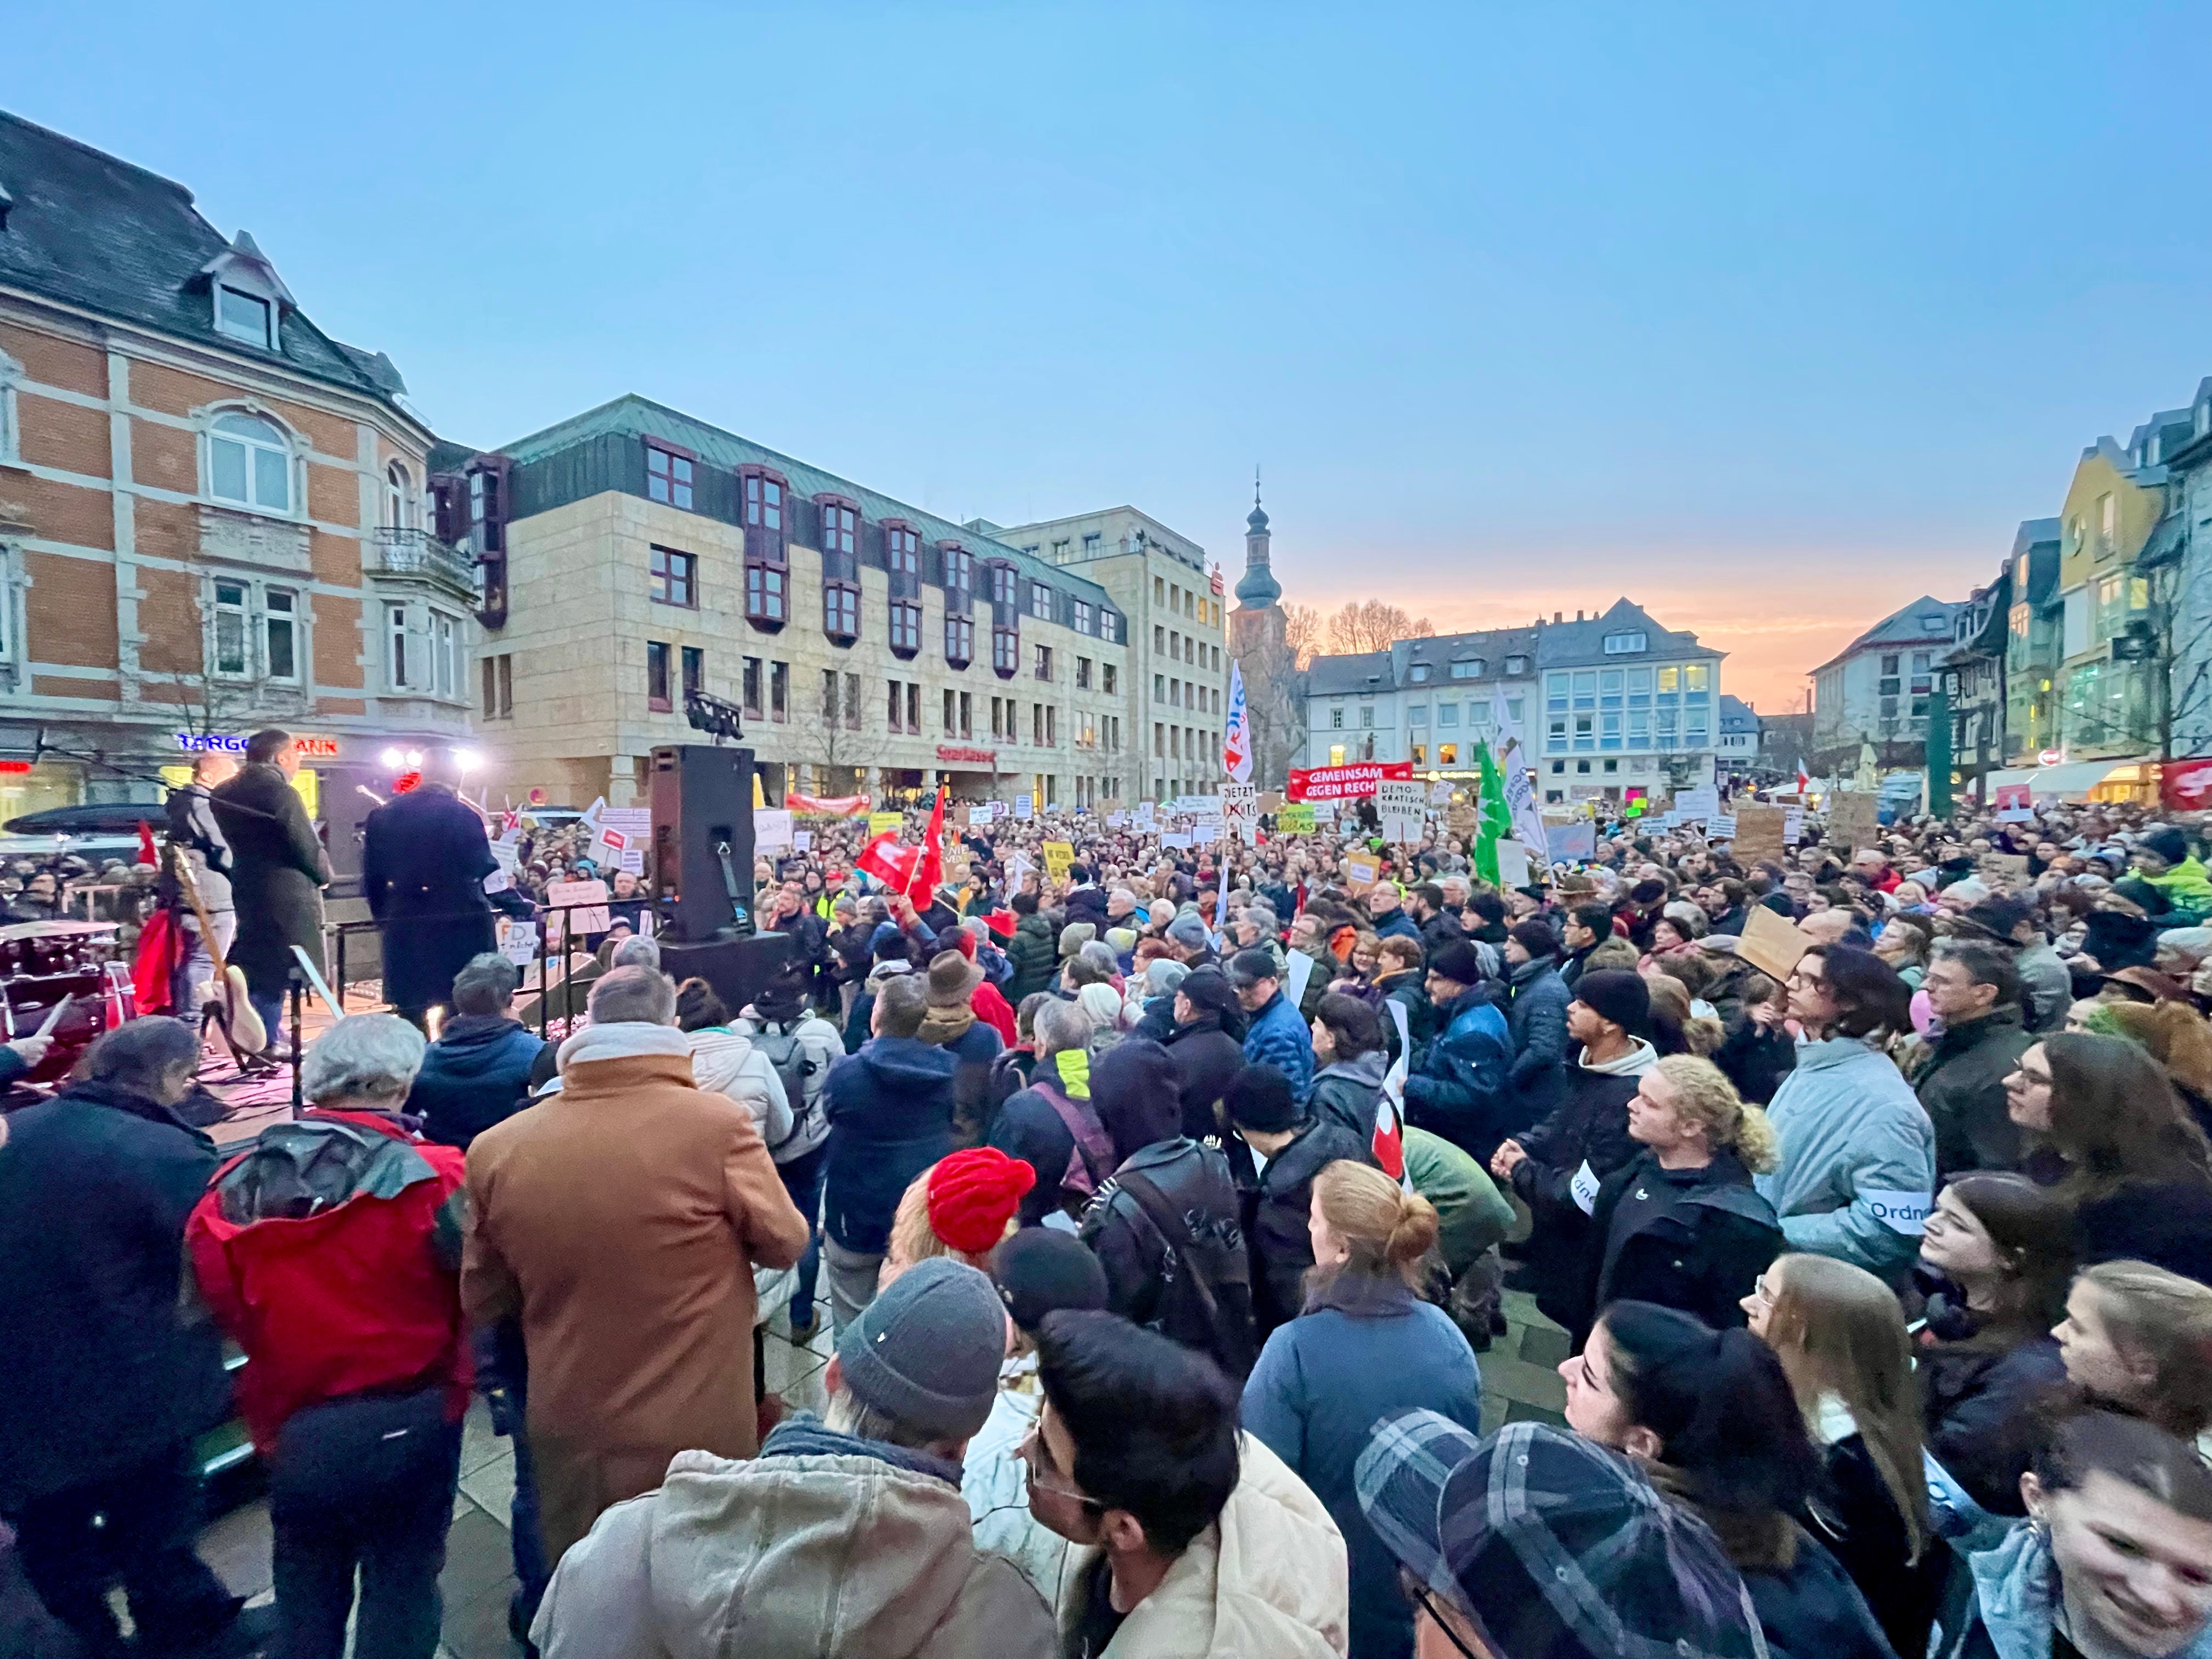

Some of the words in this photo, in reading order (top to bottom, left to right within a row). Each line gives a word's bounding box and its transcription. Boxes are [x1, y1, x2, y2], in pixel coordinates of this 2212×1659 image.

[1309, 768, 1383, 783] GEMEINSAM
[1306, 784, 1341, 797] GEGEN
[1344, 780, 1377, 793] RECH
[1382, 785, 1417, 794] DEMO-
[1381, 795, 1425, 804] KRATISCH
[1381, 804, 1421, 815] BLEIBEN
[948, 845, 969, 856] NIE
